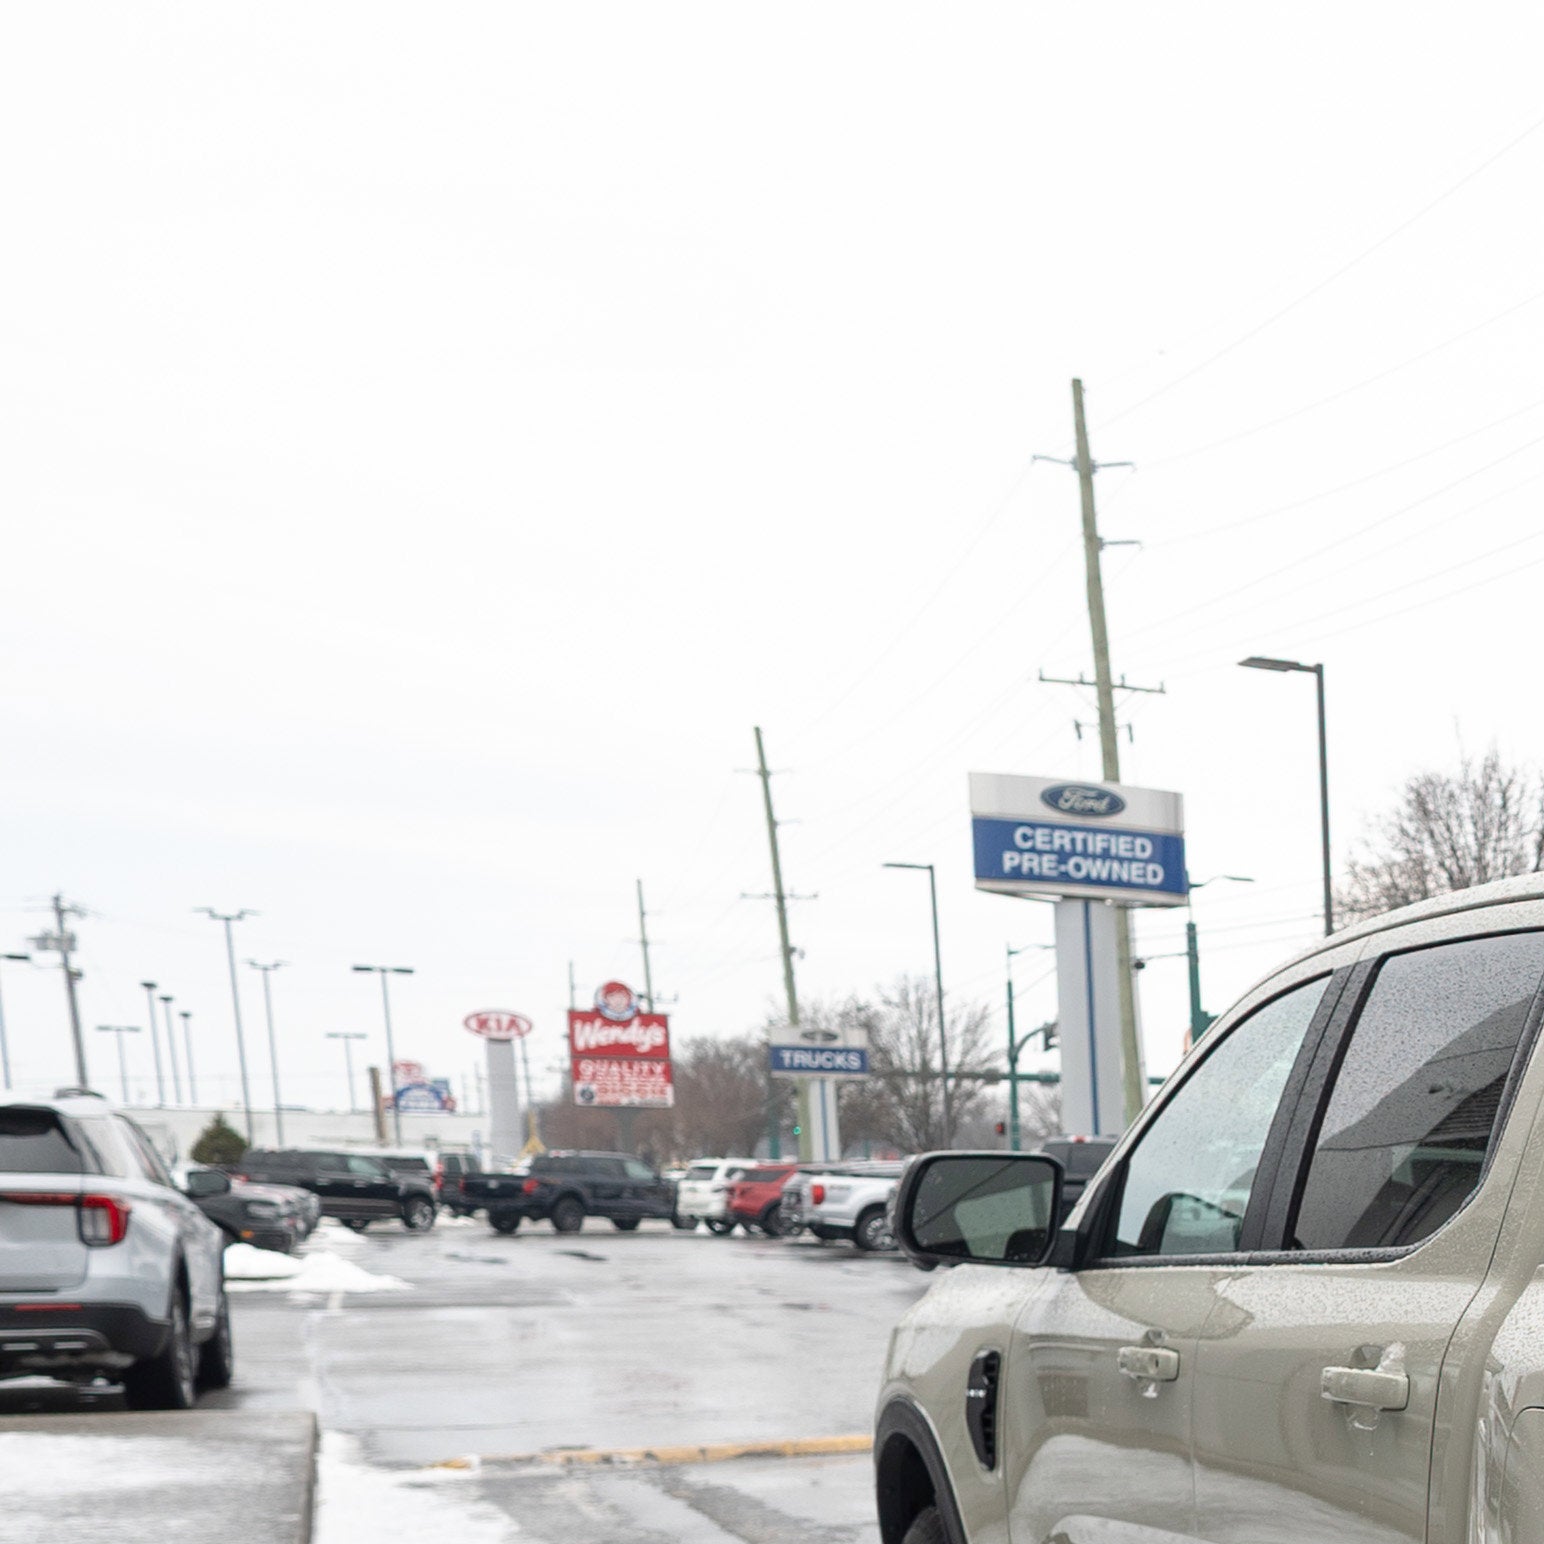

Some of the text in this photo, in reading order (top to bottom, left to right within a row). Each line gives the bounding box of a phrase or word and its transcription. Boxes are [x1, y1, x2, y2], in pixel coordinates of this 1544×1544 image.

[1058, 787, 1115, 813] Ford
[1013, 826, 1153, 860] CERTIFIED
[1002, 851, 1165, 885] PRE-OWNED
[475, 1017, 523, 1036] KIA
[574, 1018, 666, 1052] Wendy's
[579, 1059, 665, 1075] QUALITY
[781, 1050, 861, 1069] TRUCKS
